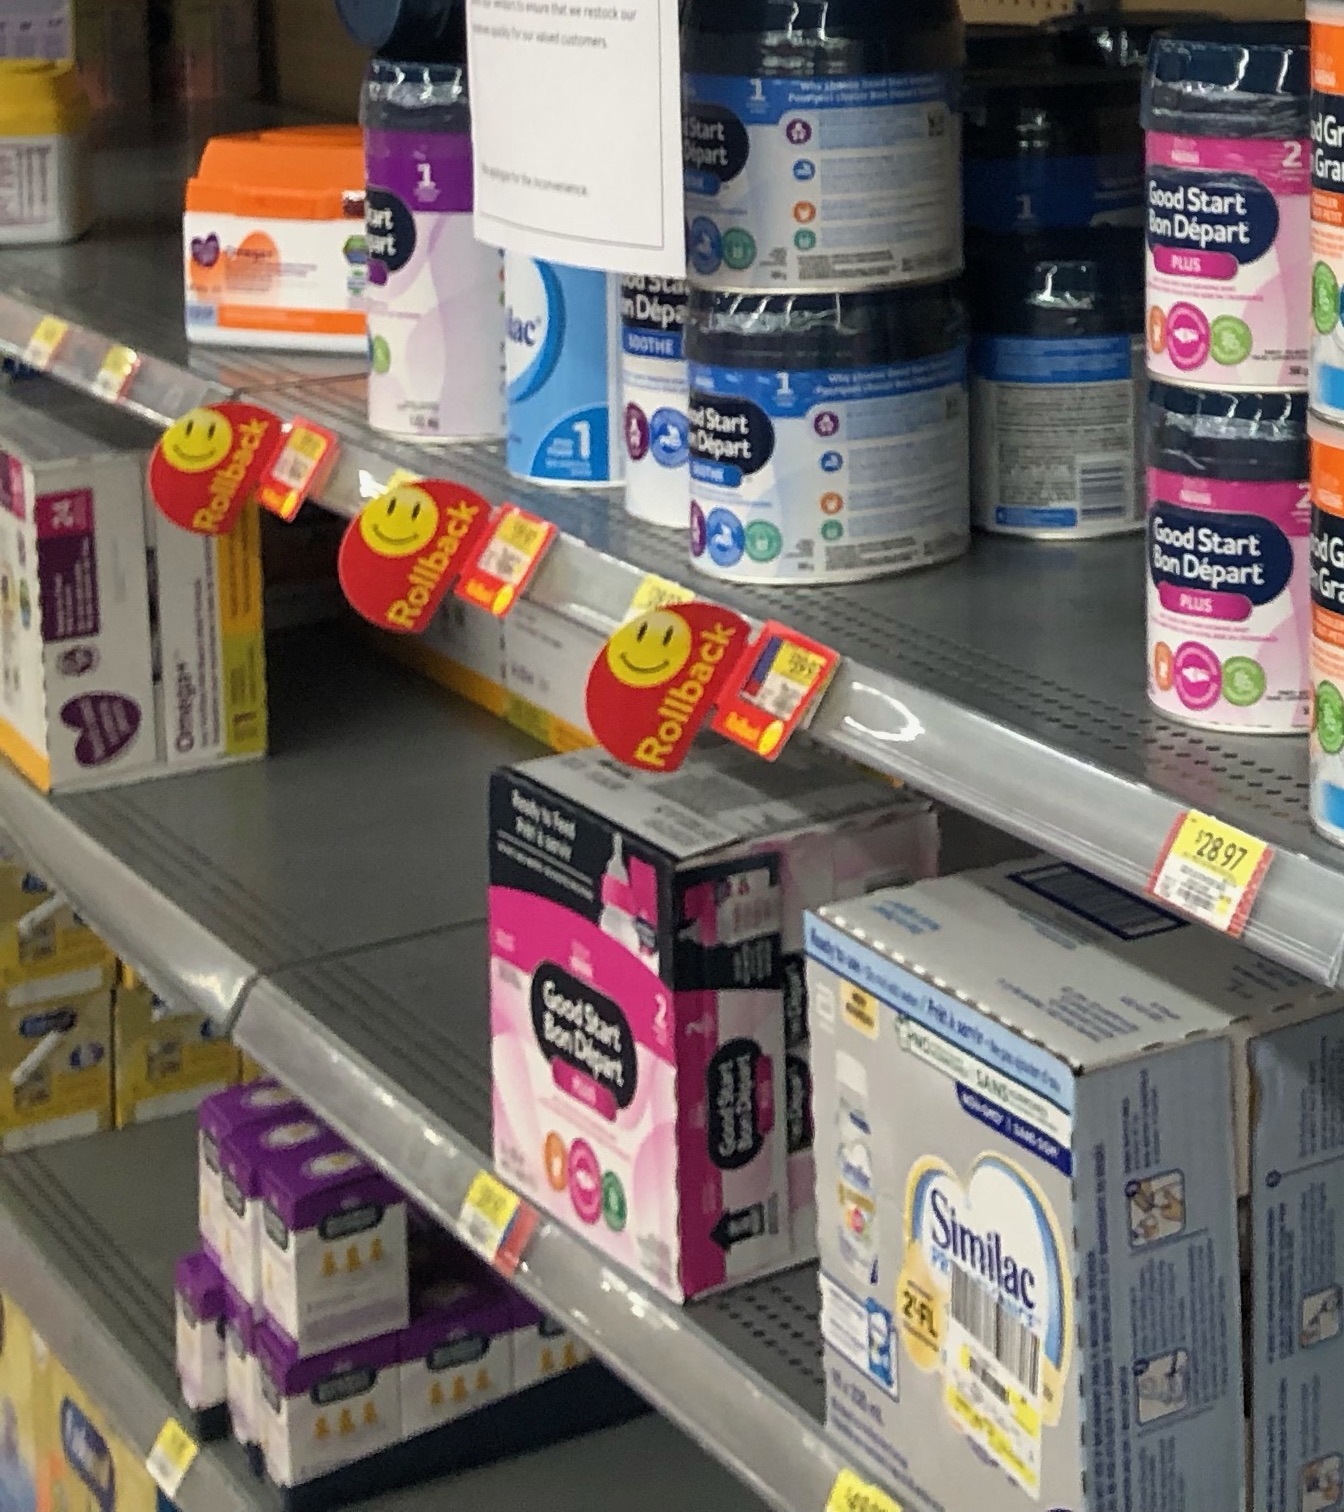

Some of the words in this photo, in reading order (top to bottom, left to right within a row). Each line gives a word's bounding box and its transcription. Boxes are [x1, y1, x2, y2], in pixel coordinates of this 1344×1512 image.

[1176, 216, 1249, 248] Départ
[1188, 188, 1246, 216] Start
[1171, 256, 1200, 272] PLUS
[193, 418, 267, 535] Rollback
[388, 498, 480, 630] Rollback
[635, 620, 736, 773] Rollback
[931, 1188, 1037, 1311] Similac
